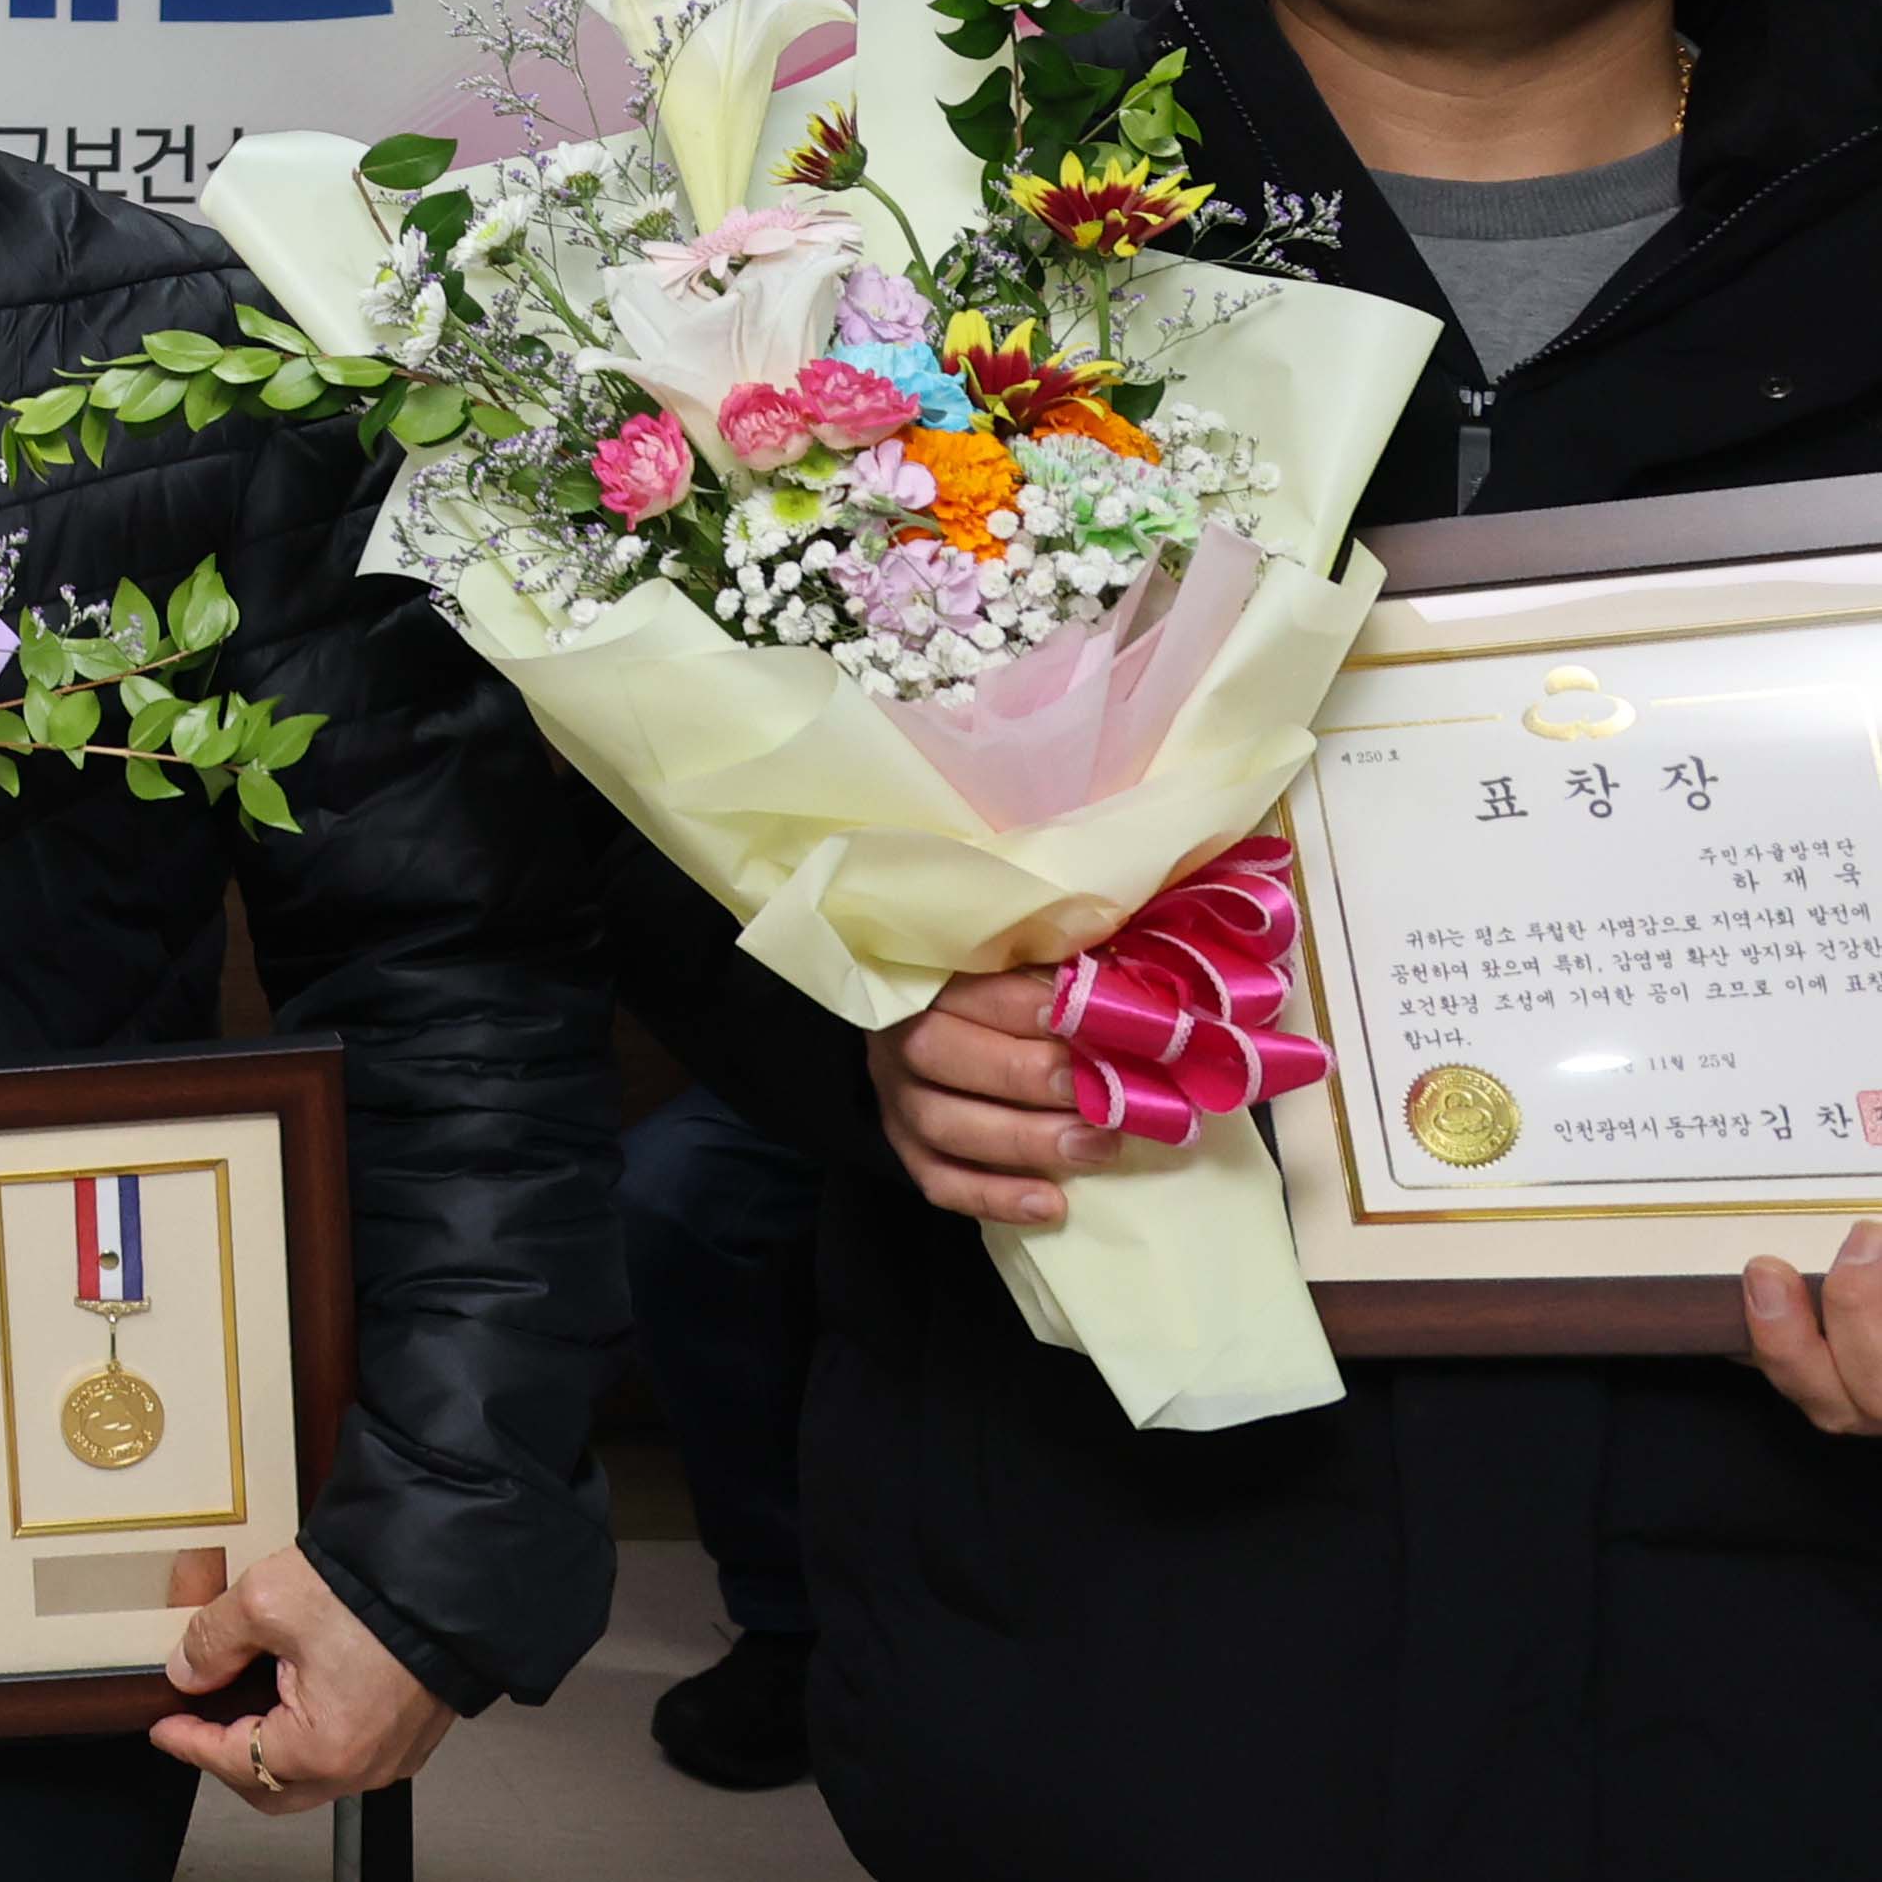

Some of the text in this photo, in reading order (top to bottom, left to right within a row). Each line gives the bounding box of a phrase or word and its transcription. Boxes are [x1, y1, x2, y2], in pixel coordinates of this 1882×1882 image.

[1699, 837, 1856, 867] 주민자율방역단
[1405, 928, 1465, 951] 귀하는
[1474, 925, 1516, 947] 평소
[1597, 914, 1702, 938] 사명감으로
[1712, 906, 1795, 931] 지역사회
[1806, 901, 1871, 927] 발전에
[1390, 959, 1469, 986] 공헌하여
[1481, 955, 1541, 980] 왔으며
[1612, 948, 1673, 973] 감염병
[1686, 945, 1730, 968] 확산
[1740, 940, 1807, 966] 방지와
[1816, 935, 1882, 962] 건강한
[1398, 993, 1479, 1017] 보건환경
[1494, 989, 1556, 1012] 조성에
[1569, 984, 1635, 1007] 기여한
[1647, 981, 1690, 1005] 공이
[1705, 978, 1773, 1000] 크므로
[1784, 973, 1828, 996] 이에
[1403, 1027, 1472, 1051] 합니다.
[1553, 1115, 1659, 1143] 인천광역시
[1664, 1112, 1752, 1140] 동구청장
